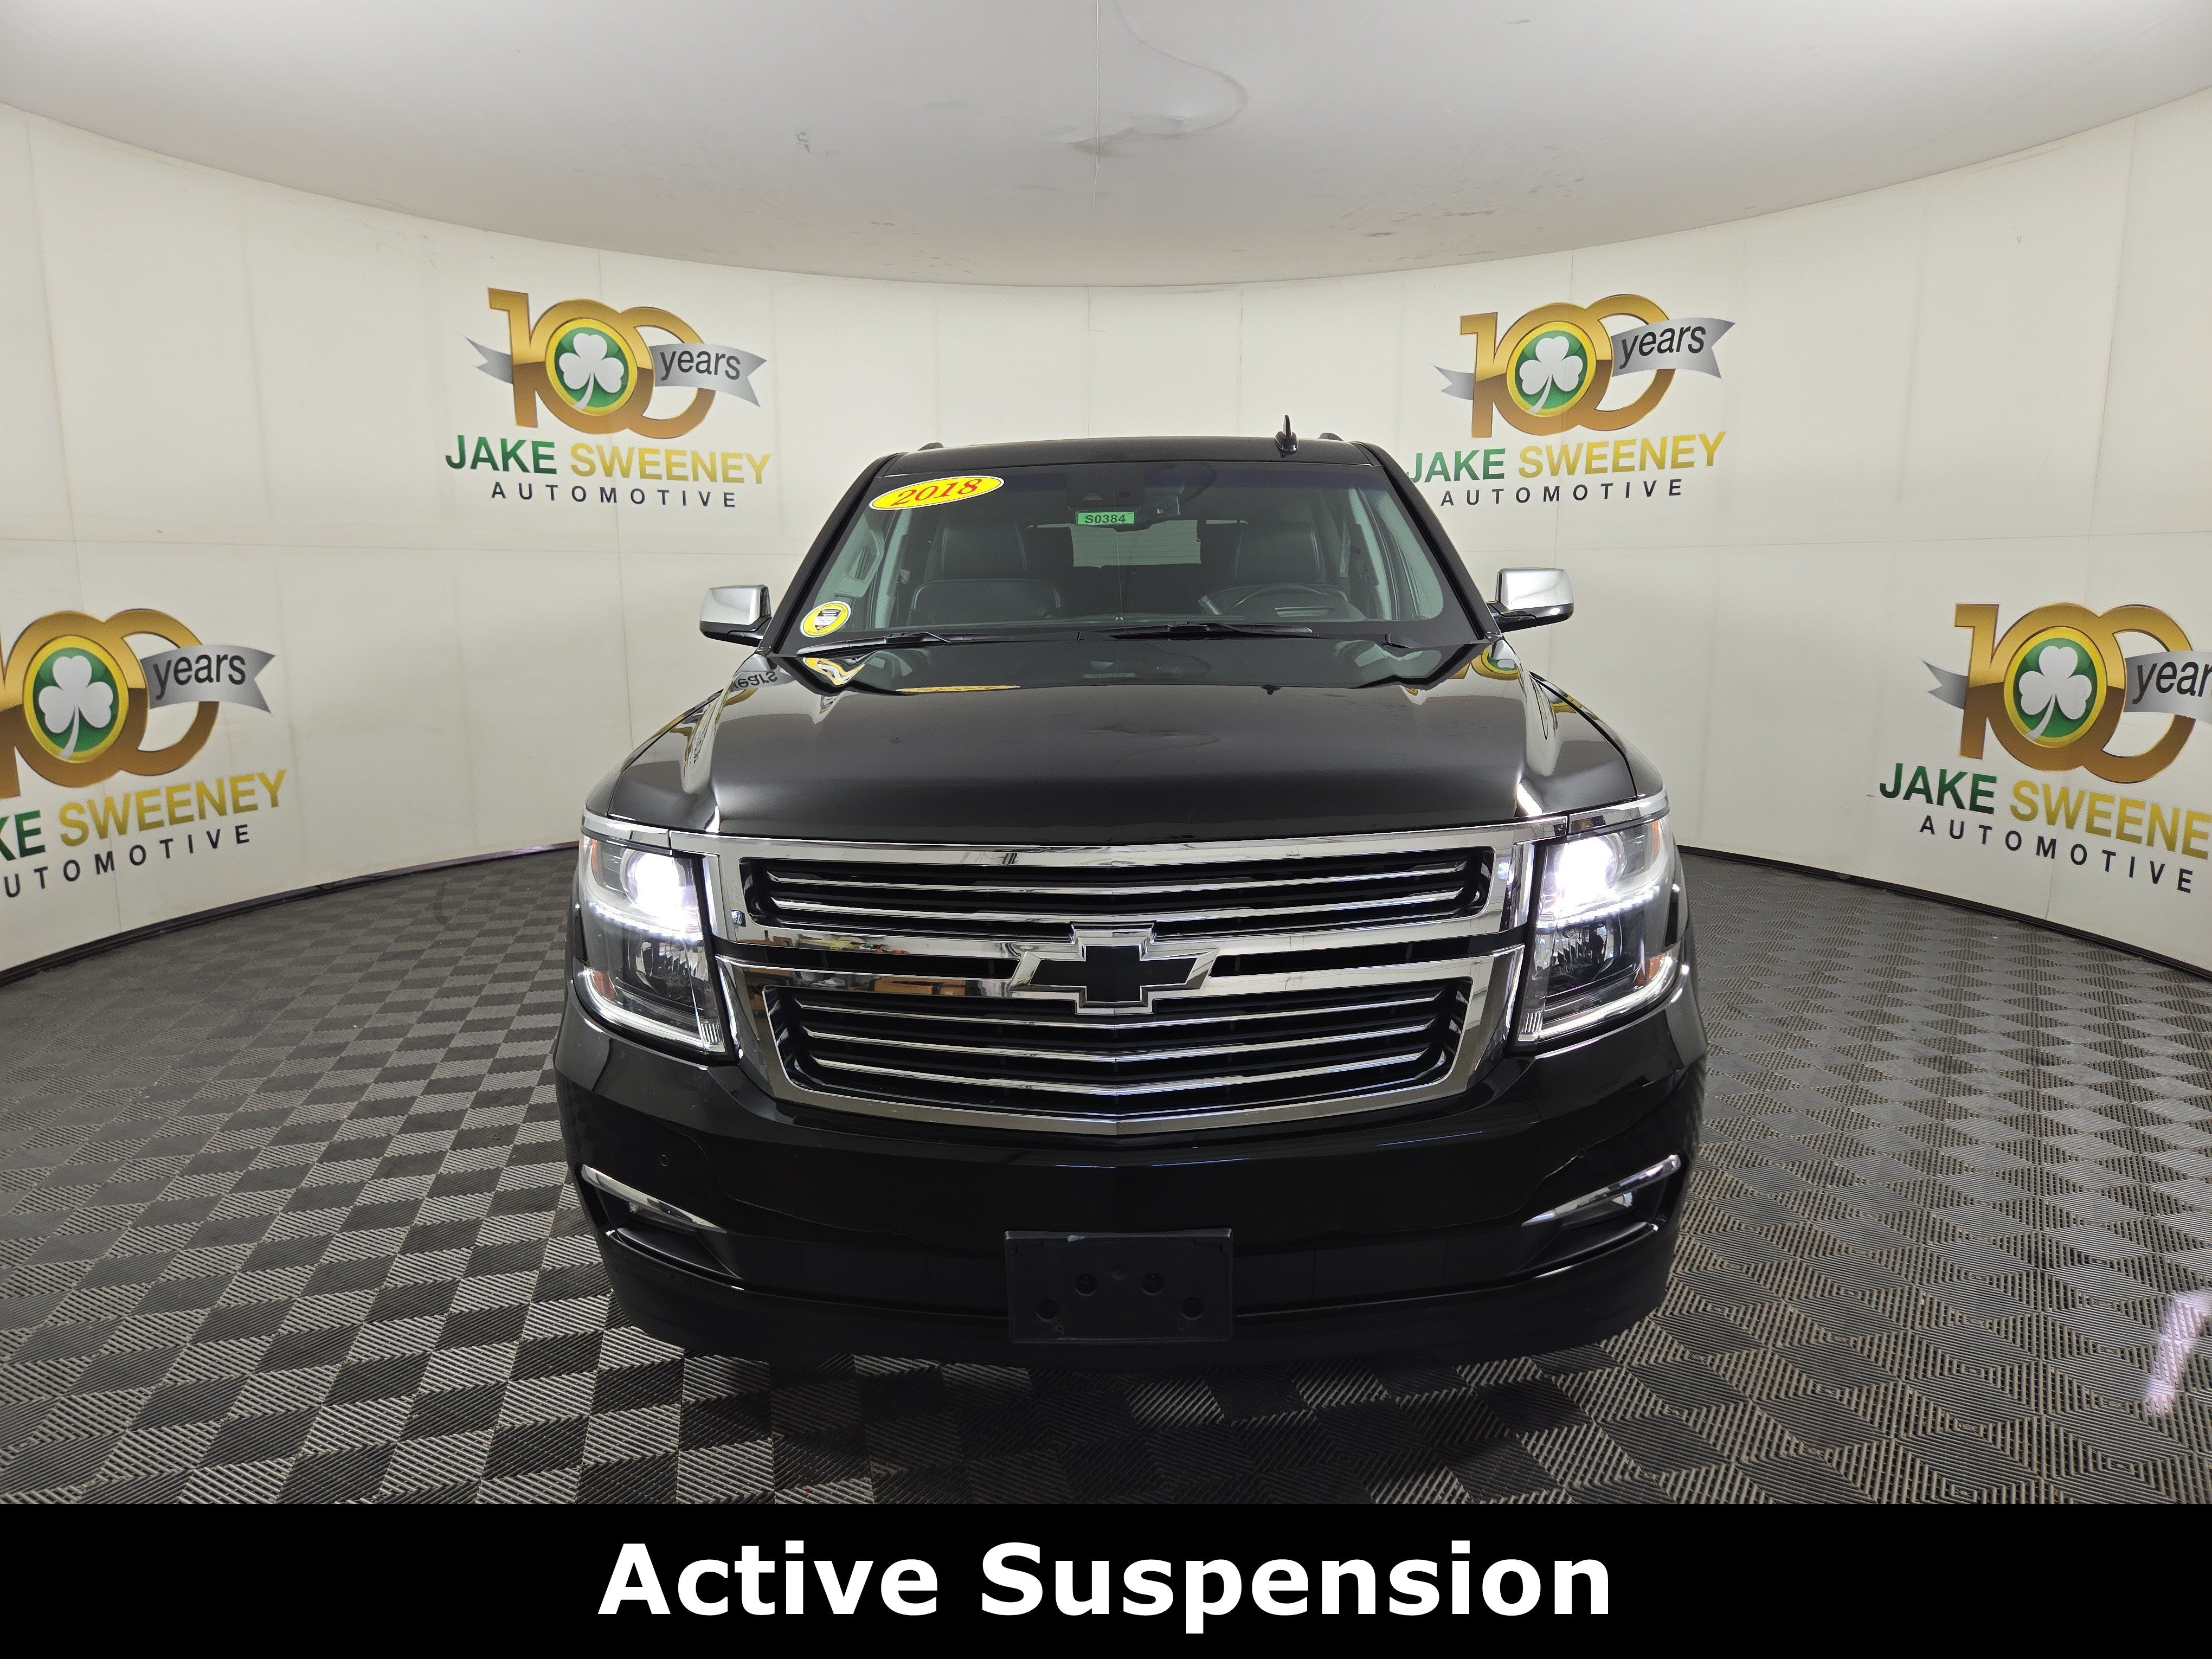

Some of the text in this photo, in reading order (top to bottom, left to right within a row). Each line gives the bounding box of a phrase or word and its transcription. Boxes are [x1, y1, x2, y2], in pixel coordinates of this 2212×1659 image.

[488, 287, 741, 439] 100 years
[1460, 294, 1706, 438] 100 years
[445, 434, 771, 484] JAKE SWEENEY
[1406, 431, 1727, 483] JAKE SWEENEY
[491, 481, 736, 507] AUTOMOTIVE
[890, 479, 982, 507] 2018
[1084, 515, 1126, 524] S0384
[1441, 478, 1682, 506] AUTOMOTIVE
[153, 653, 246, 700] years
[1954, 602, 2212, 784] 100 year
[59, 769, 286, 847] SWEENEY
[1880, 763, 2212, 860] JAKE SWEENE
[4, 824, 250, 898] UTOMOTIVE
[1919, 815, 2193, 893] AUTOMOTIVE
